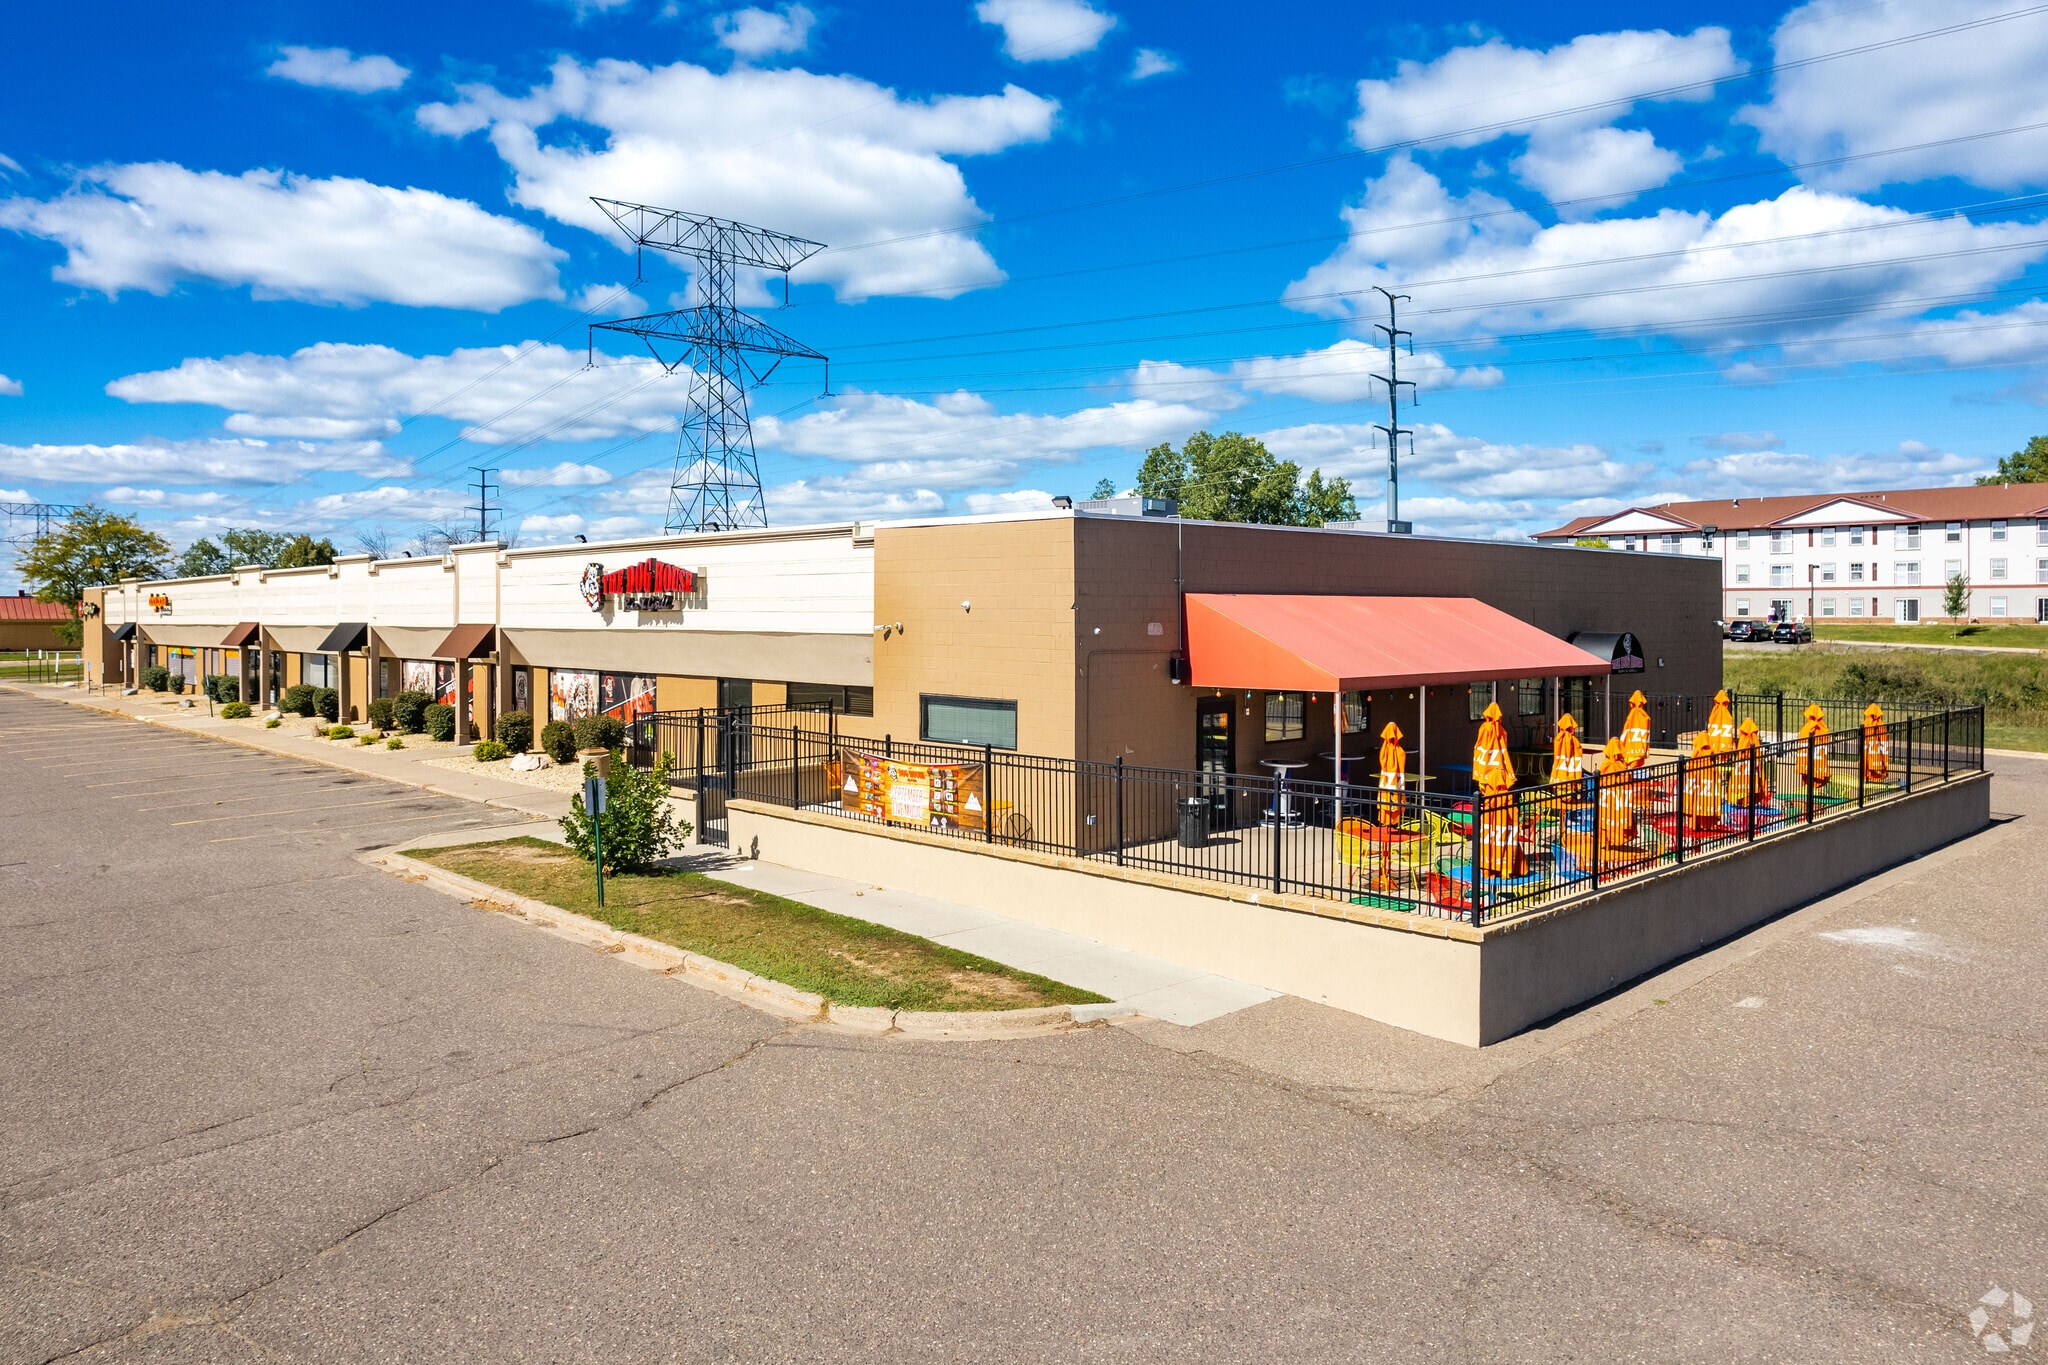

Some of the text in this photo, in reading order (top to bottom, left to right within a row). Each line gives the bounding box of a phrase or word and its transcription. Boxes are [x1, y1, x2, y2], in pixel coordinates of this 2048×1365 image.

[602, 557, 693, 594] THE DOG HOUSE
